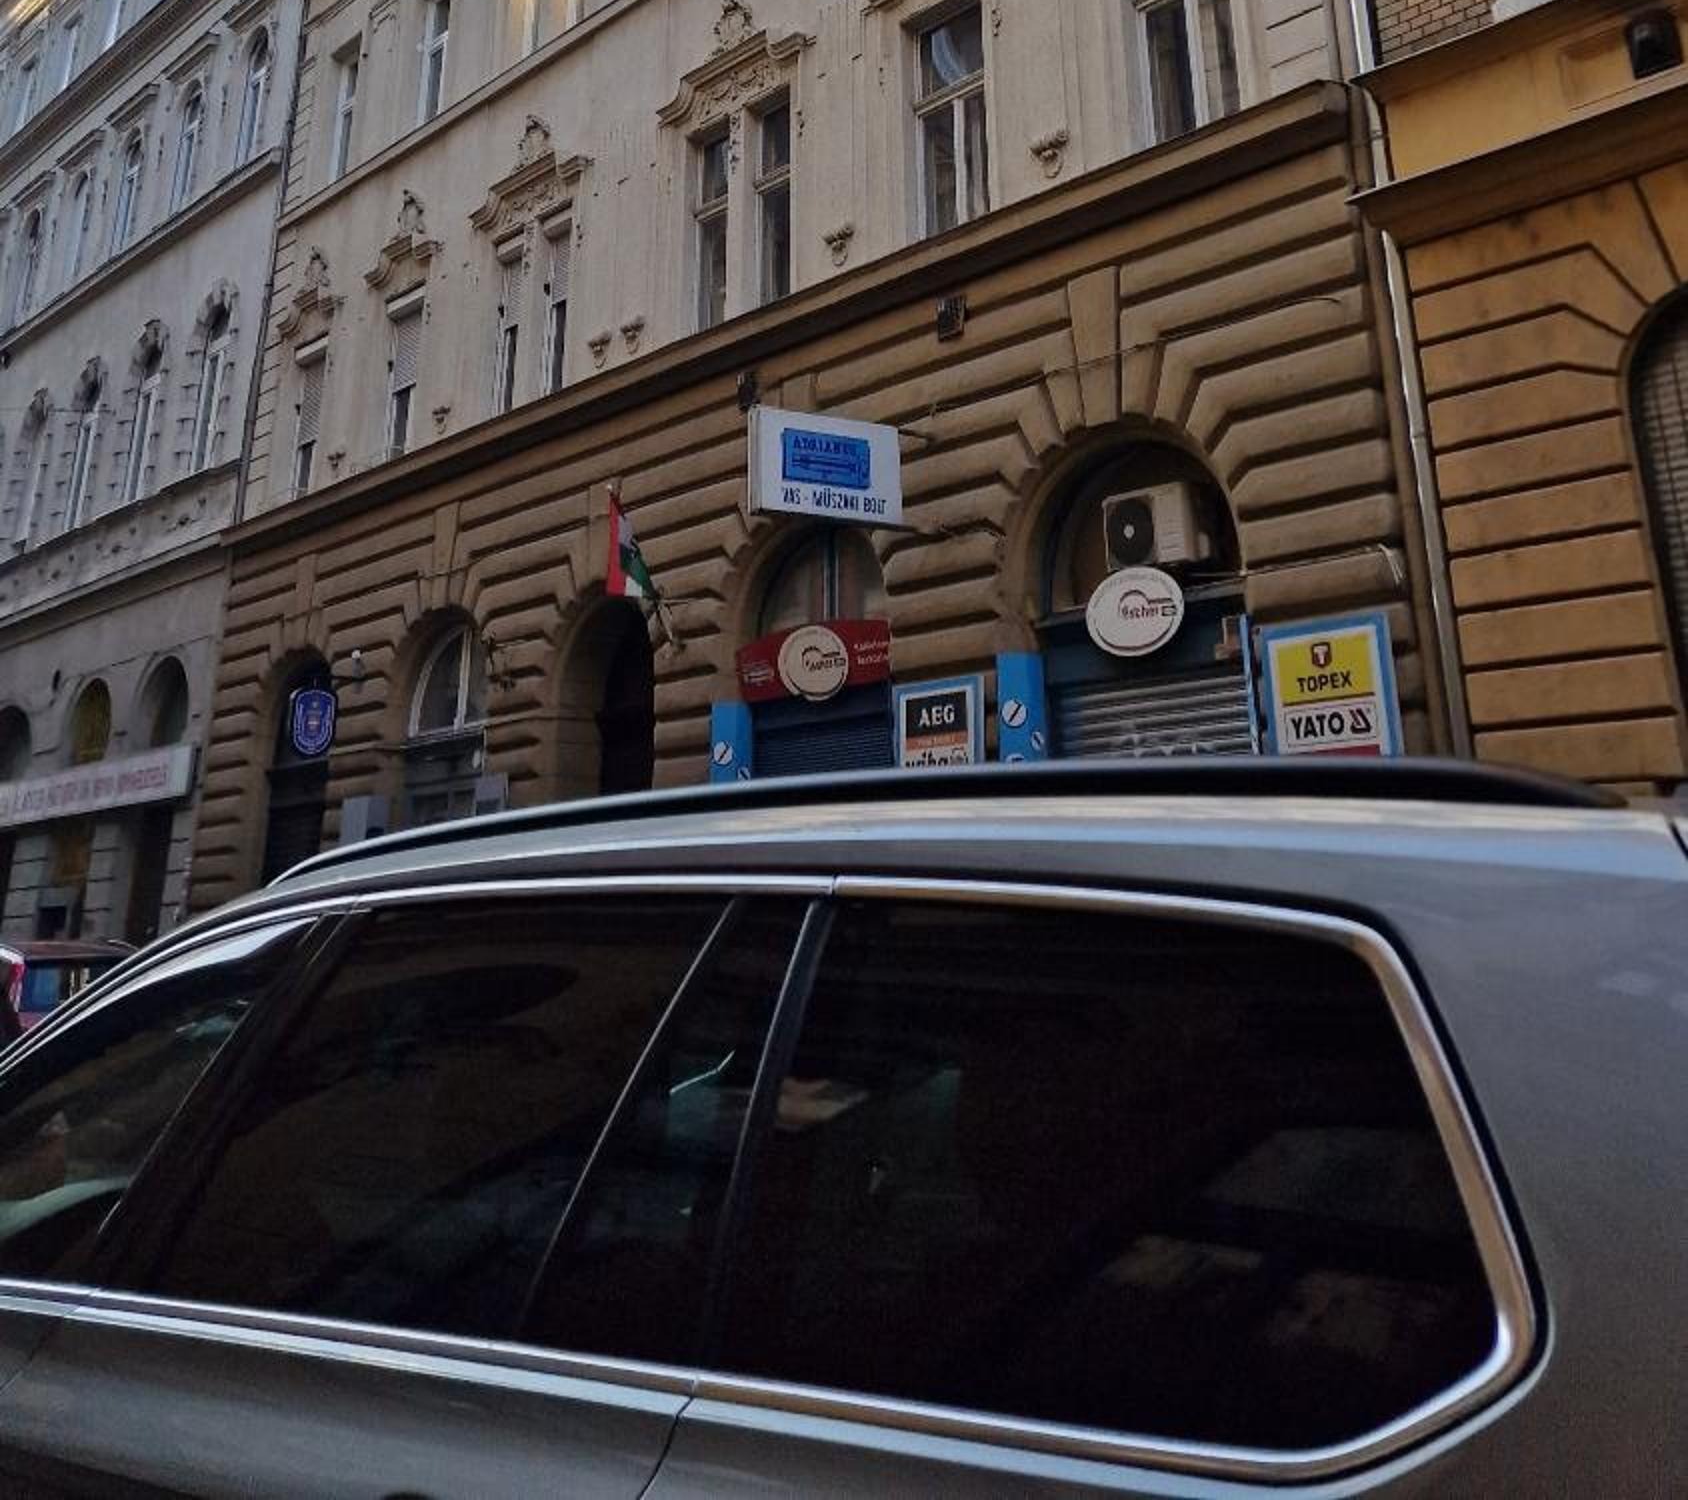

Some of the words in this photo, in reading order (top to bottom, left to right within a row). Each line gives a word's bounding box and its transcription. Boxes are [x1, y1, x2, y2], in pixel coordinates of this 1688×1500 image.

[864, 496, 887, 515] BOLT
[1297, 670, 1352, 693] TOPEX
[918, 703, 955, 728] AEG
[1291, 711, 1345, 740] YATO
